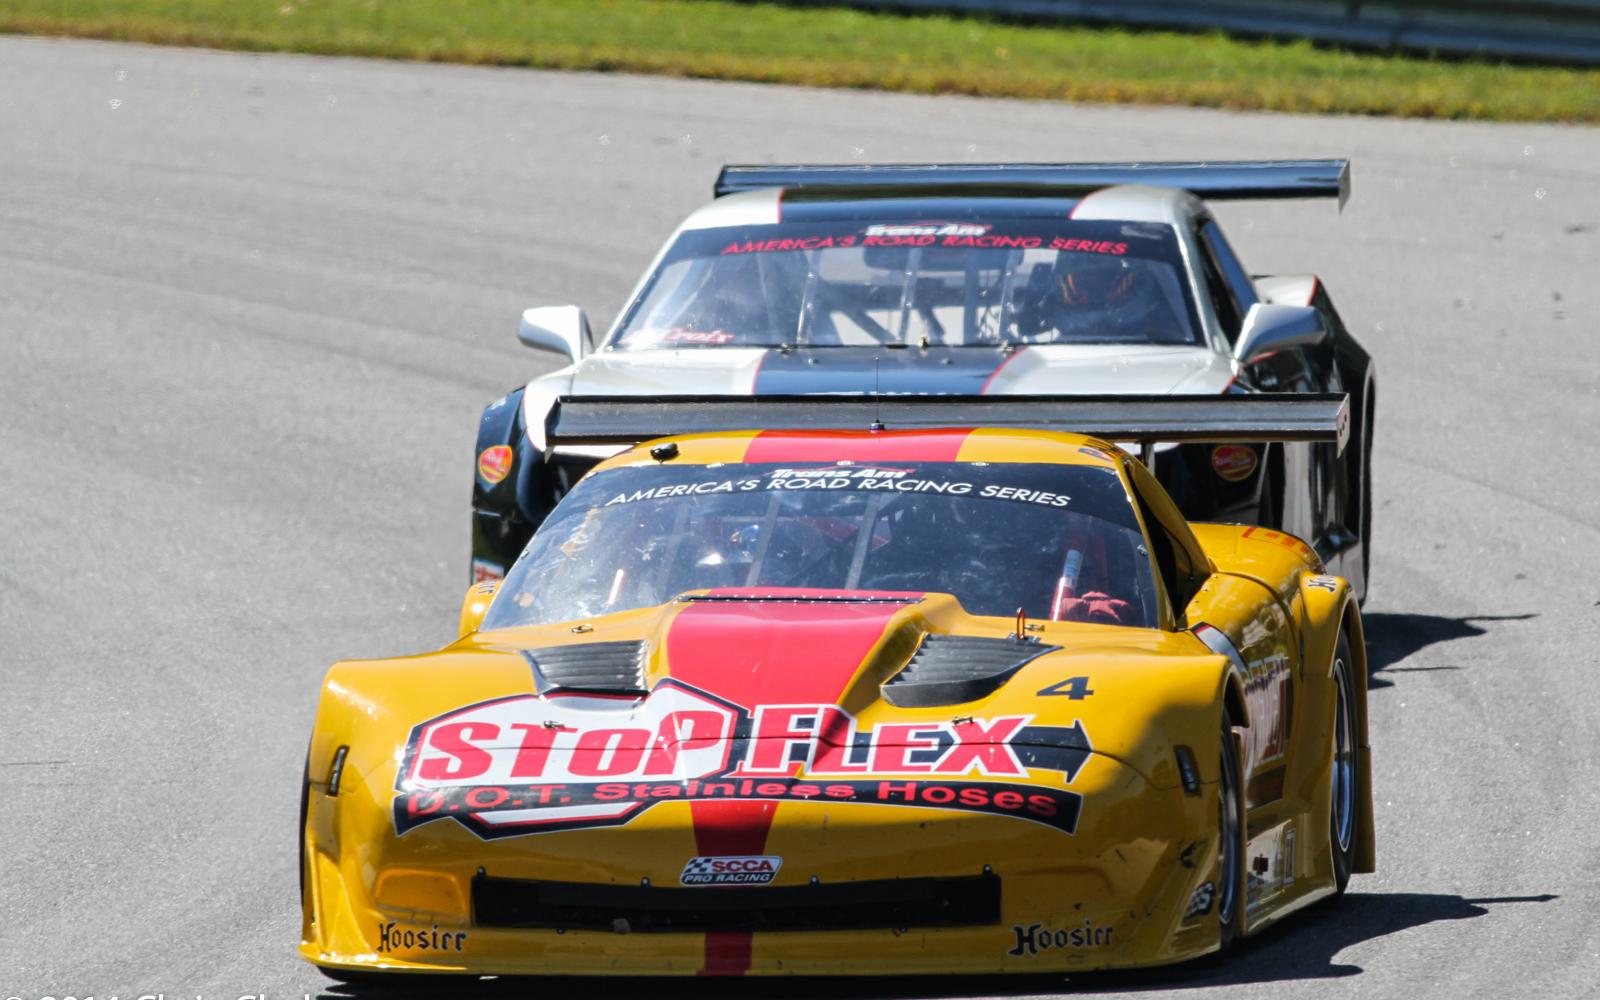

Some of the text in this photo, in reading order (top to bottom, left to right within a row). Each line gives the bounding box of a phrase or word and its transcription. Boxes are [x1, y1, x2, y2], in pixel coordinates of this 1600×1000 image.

[720, 235, 1128, 255] AMERICA'S ROAD RACING SERIES
[770, 468, 908, 479] Trans Am
[604, 478, 1071, 507] AMERICA'S ROAD RACING SERIES
[1036, 676, 1095, 700] 4
[406, 779, 1057, 816] D.O.T. Stainless Hoses
[684, 873, 771, 883] PRO RACING
[711, 860, 774, 873] SCCA
[376, 920, 467, 954] Hoosier
[1008, 919, 1114, 956] Hoosier
